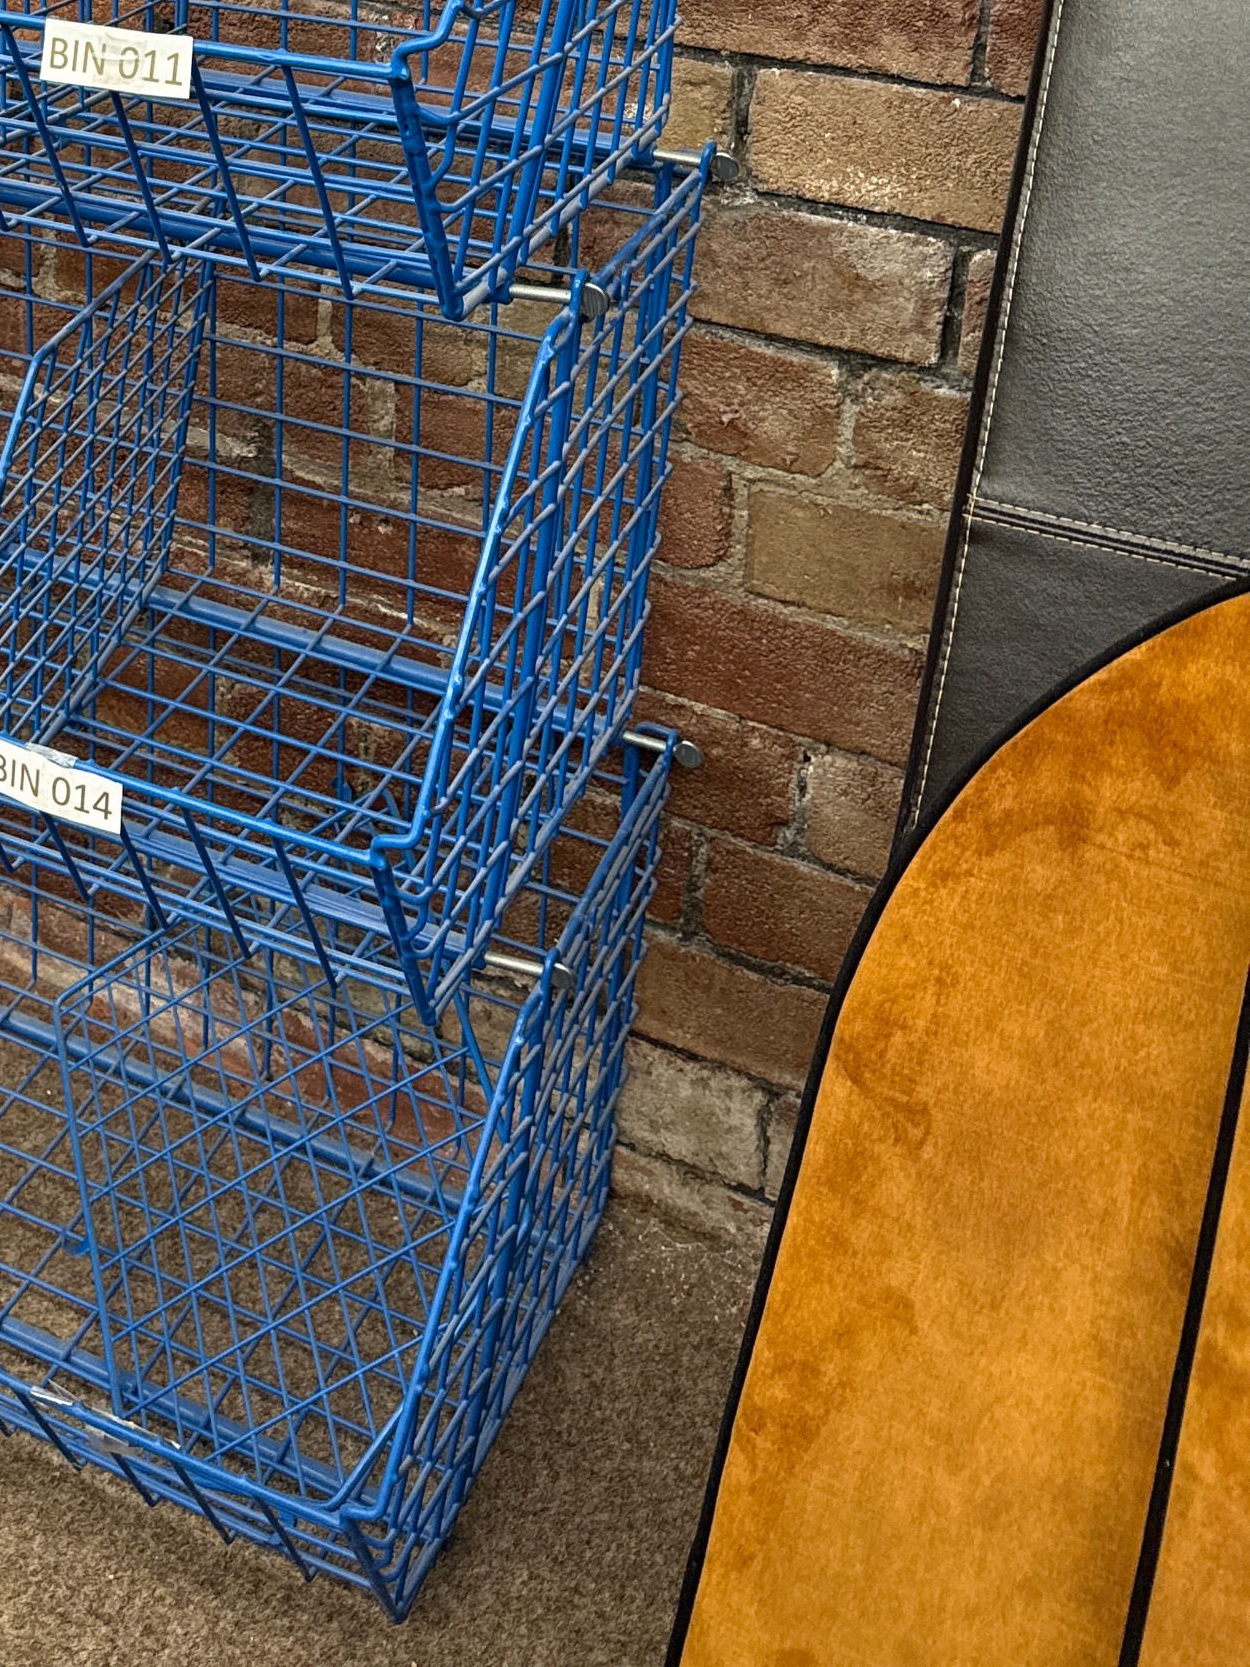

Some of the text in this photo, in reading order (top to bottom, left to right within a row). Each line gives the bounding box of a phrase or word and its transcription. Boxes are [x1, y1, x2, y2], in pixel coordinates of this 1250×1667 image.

[49, 37, 182, 86] BIN 011
[52, 776, 112, 820] 014
